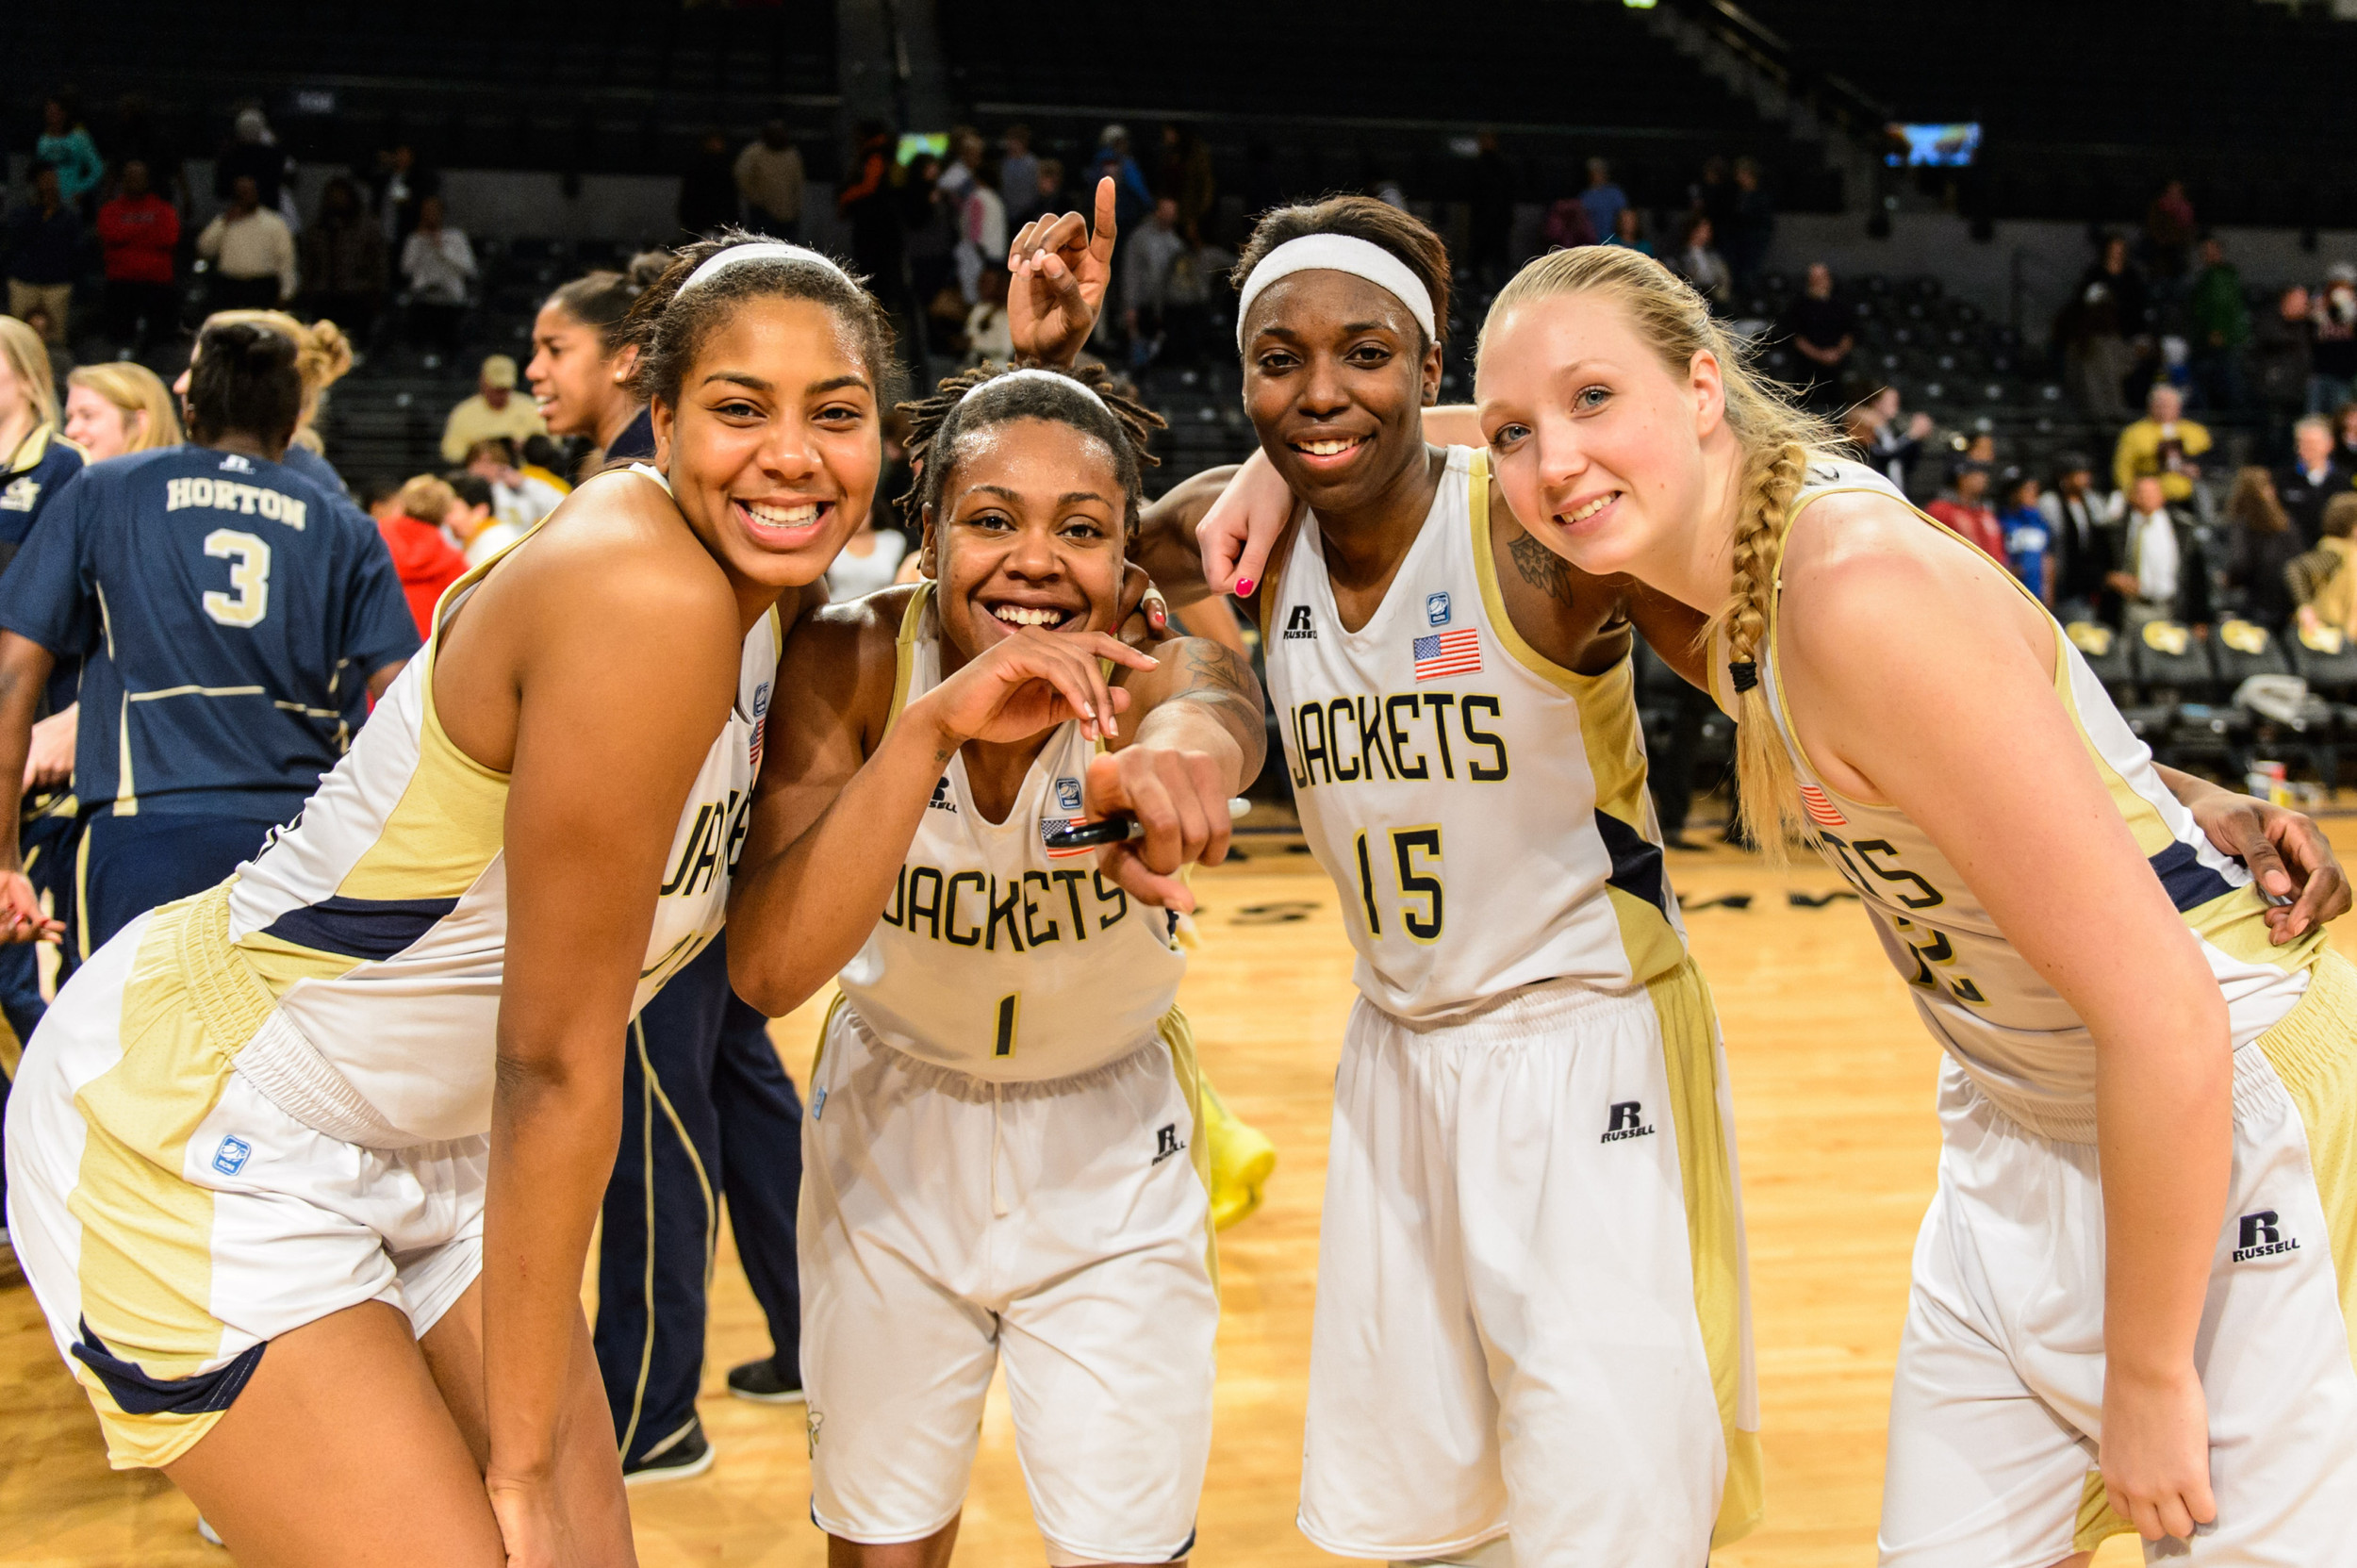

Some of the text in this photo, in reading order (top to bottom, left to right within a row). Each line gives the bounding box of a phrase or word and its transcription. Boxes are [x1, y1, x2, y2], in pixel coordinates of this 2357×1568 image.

[166, 477, 306, 532] HORTON
[203, 528, 272, 629] 3
[1287, 605, 1311, 630] R
[1290, 691, 1509, 790] JACKETS
[882, 863, 1128, 953] JACKETS
[1353, 822, 1445, 947] 15
[991, 991, 1021, 1060] 1
[1600, 1124, 1656, 1144] RUSSELL
[1607, 1100, 1641, 1132] R
[2233, 1238, 2300, 1263] RUSSELL
[2238, 1211, 2279, 1249] R
